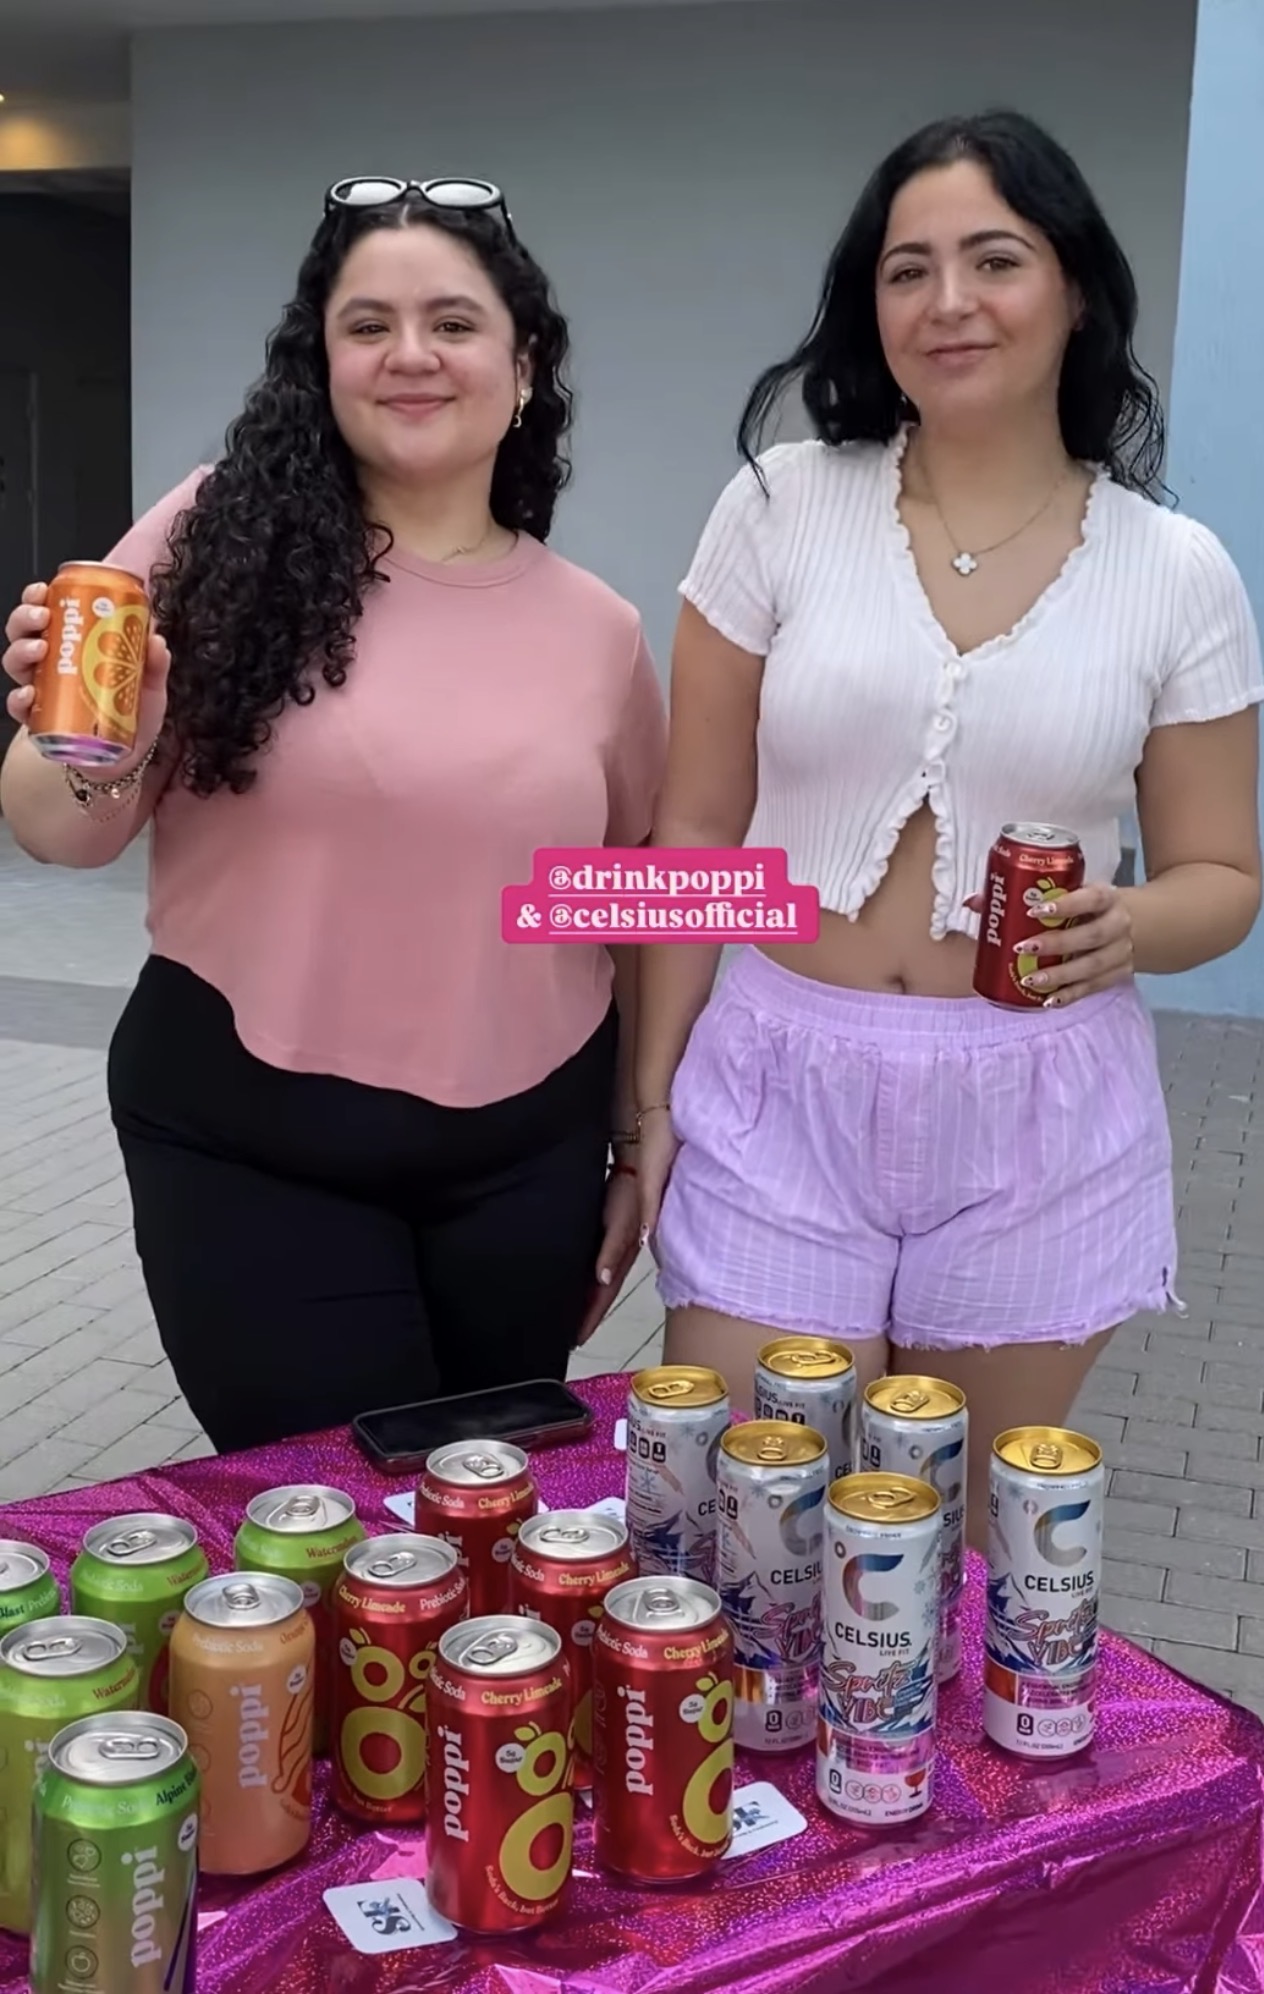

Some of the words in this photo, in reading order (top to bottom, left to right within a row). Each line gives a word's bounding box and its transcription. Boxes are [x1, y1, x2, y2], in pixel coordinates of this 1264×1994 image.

[57, 596, 84, 675] poppi
[986, 871, 1008, 948] poppi
[442, 1495, 465, 1510] Soda
[478, 1496, 511, 1510] Cherry
[559, 1573, 596, 1587] Cherry
[1024, 1570, 1095, 1593] CELSIUS
[338, 1584, 361, 1610] Cherry
[361, 1597, 406, 1614] Limeade
[834, 1621, 912, 1649] CELSIUS
[621, 1641, 649, 1659] Soda
[663, 1646, 702, 1660] Cherry
[879, 1649, 898, 1657] LIVE
[442, 1680, 466, 1702] Soda
[480, 1690, 523, 1706] Cherry
[522, 1677, 563, 1701] Limeade
[229, 1684, 270, 1788] poppi
[617, 1684, 654, 1796] poppi
[156, 1780, 188, 1807] Alpine
[437, 1724, 470, 1843] poppi
[120, 1844, 165, 1968] poppi
